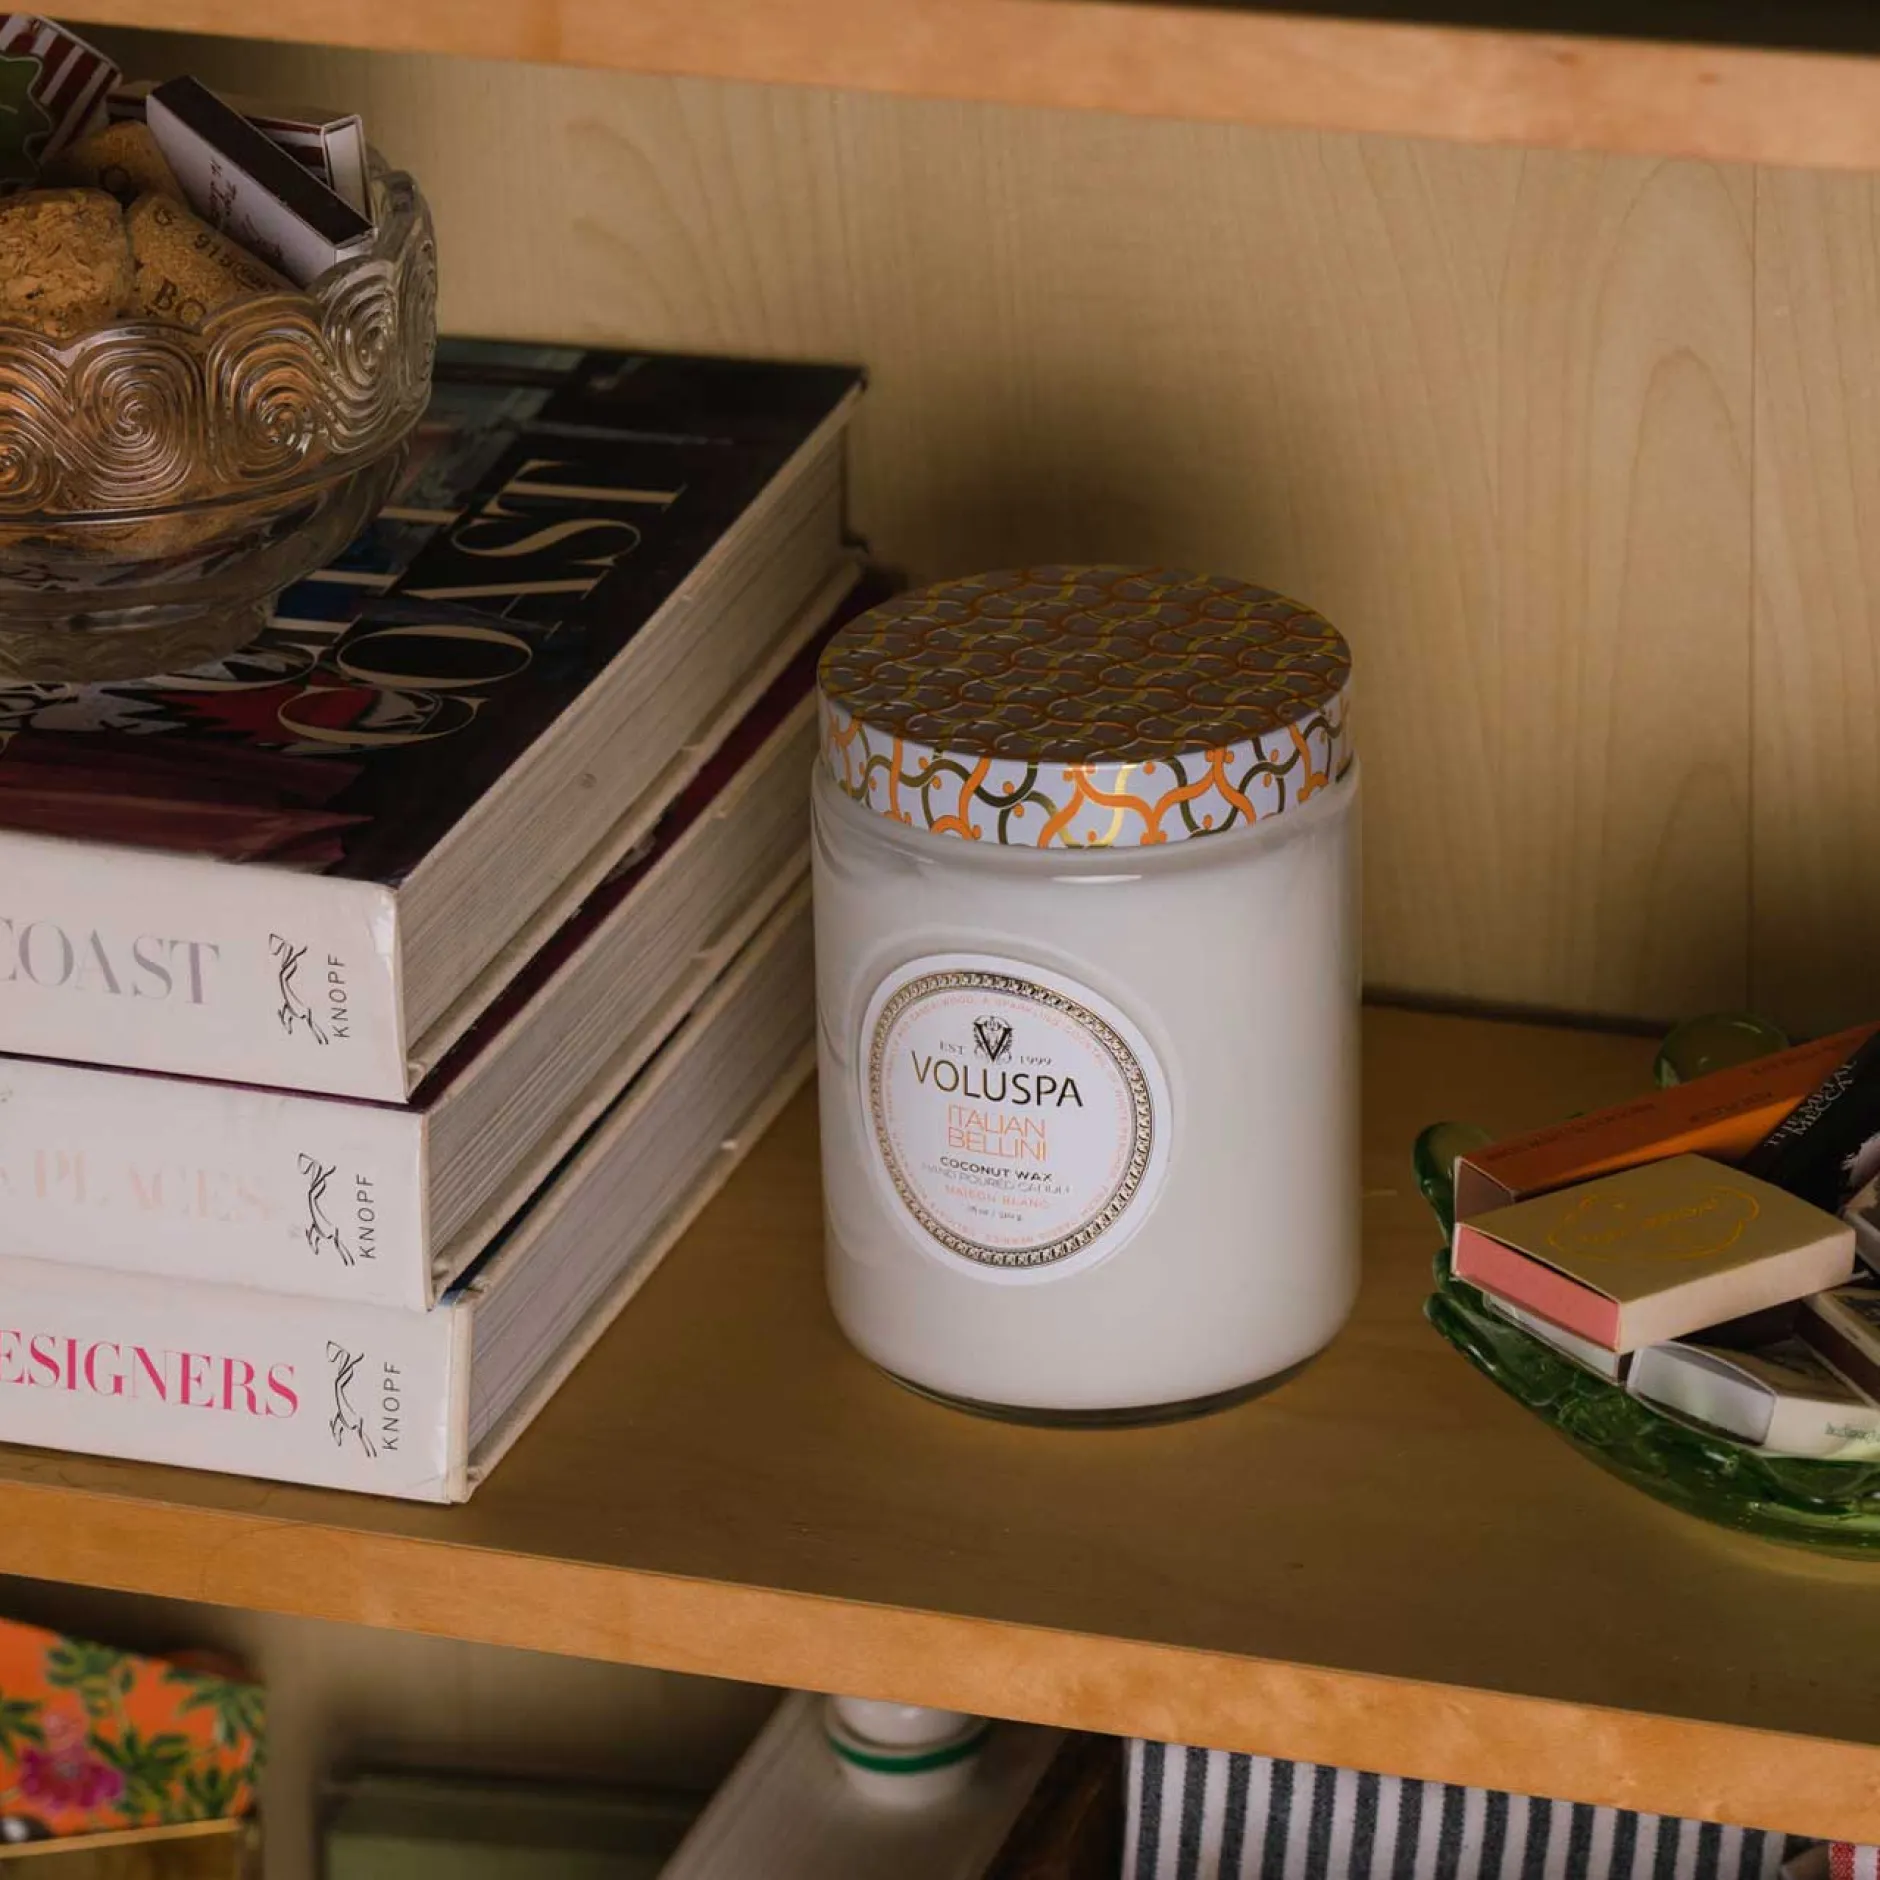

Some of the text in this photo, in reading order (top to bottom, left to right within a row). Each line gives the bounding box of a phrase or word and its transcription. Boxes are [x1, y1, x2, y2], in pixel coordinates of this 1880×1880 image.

[278, 458, 688, 745] COAST
[327, 954, 350, 1038] KNOPF
[911, 1050, 1083, 1107] VOLUSPA
[948, 1104, 1045, 1139] ITALIAN
[948, 1126, 1047, 1161] BELLINI
[940, 1155, 1053, 1183] COCONUT WAX
[358, 1173, 376, 1259] KNOPF
[381, 1360, 402, 1450] KNOPF
